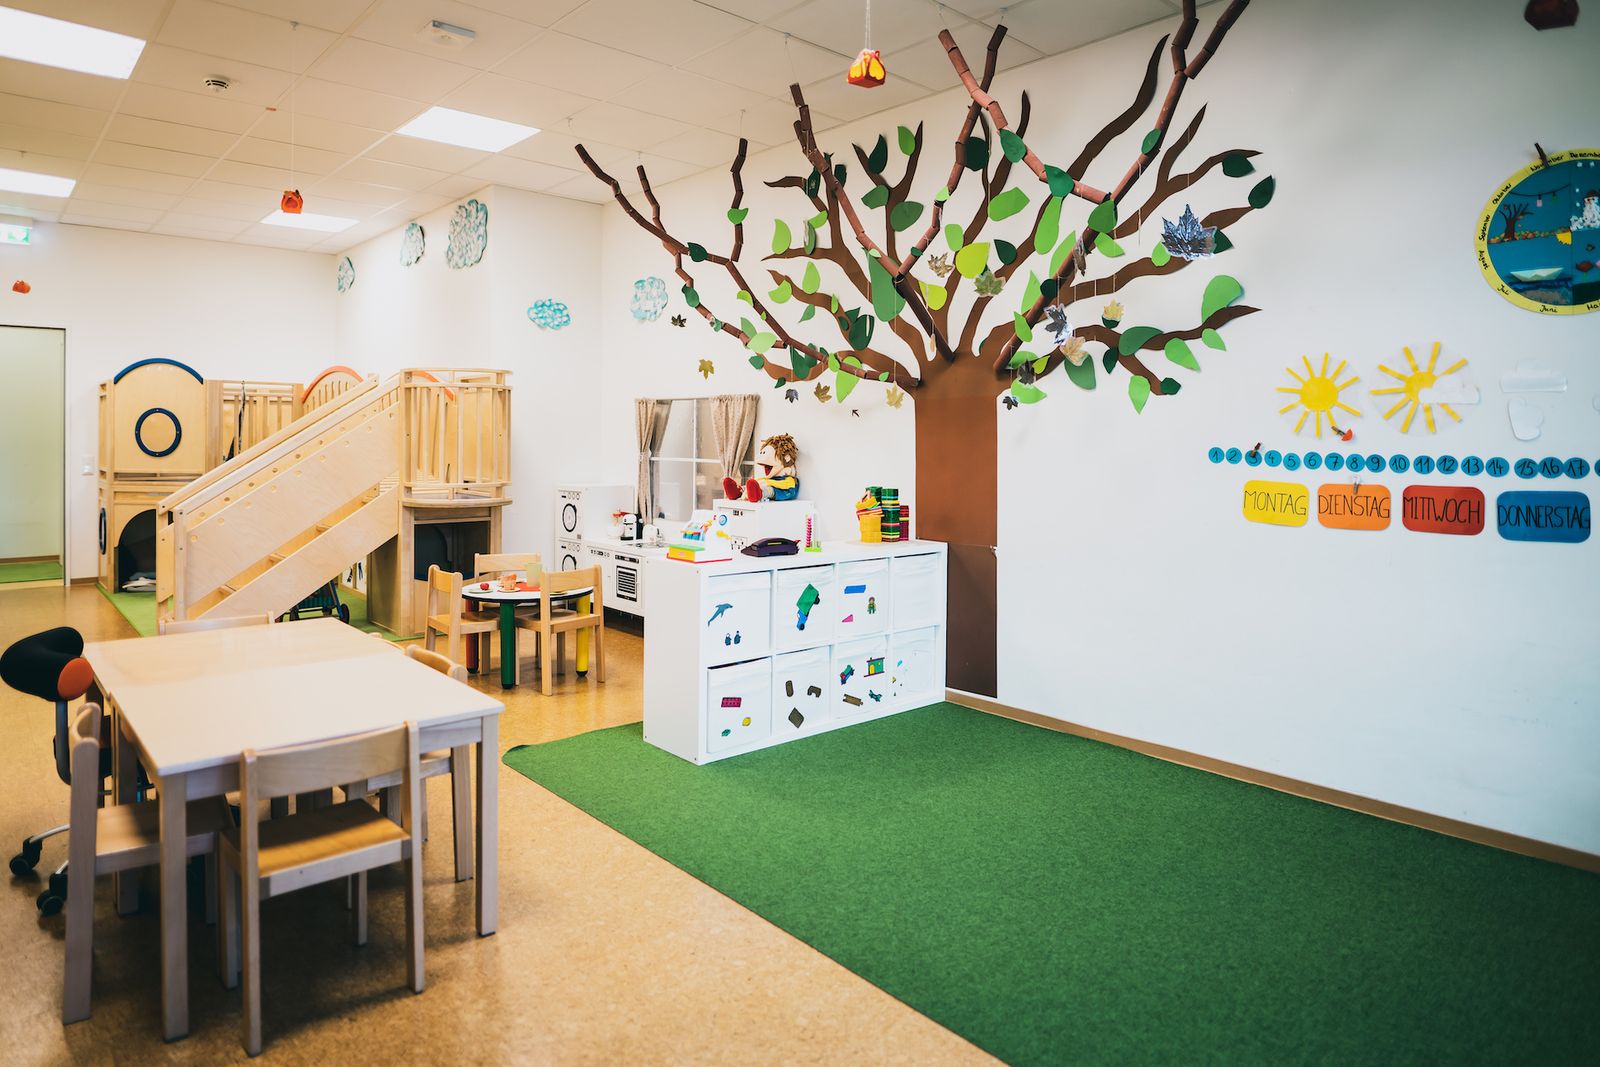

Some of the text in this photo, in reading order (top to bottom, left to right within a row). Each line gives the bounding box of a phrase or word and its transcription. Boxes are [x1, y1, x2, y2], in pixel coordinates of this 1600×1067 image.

[1478, 250, 1490, 270] August
[1497, 284, 1511, 296] Juli
[1540, 304, 1558, 313] Juni
[1212, 450, 1218, 461] 1
[1229, 450, 1238, 461] 2
[1268, 453, 1276, 464] 4
[1287, 455, 1296, 467] 5
[1308, 454, 1317, 467] 6
[1329, 455, 1339, 468] 7
[1350, 457, 1359, 470] 8
[1370, 456, 1380, 470] 9
[1392, 459, 1407, 470] 10
[1415, 458, 1430, 473] 11
[1438, 458, 1455, 471] 12
[1463, 458, 1480, 473] 13
[1488, 459, 1503, 474] 14
[1517, 460, 1536, 476] 15
[1542, 459, 1560, 476] 16
[1567, 459, 1585, 477] 17
[1243, 490, 1307, 516] MONTAG
[1318, 494, 1390, 518] DIENSTAG
[1403, 496, 1480, 524] MITTWOCH
[1497, 504, 1590, 528] DONNERSTAG
